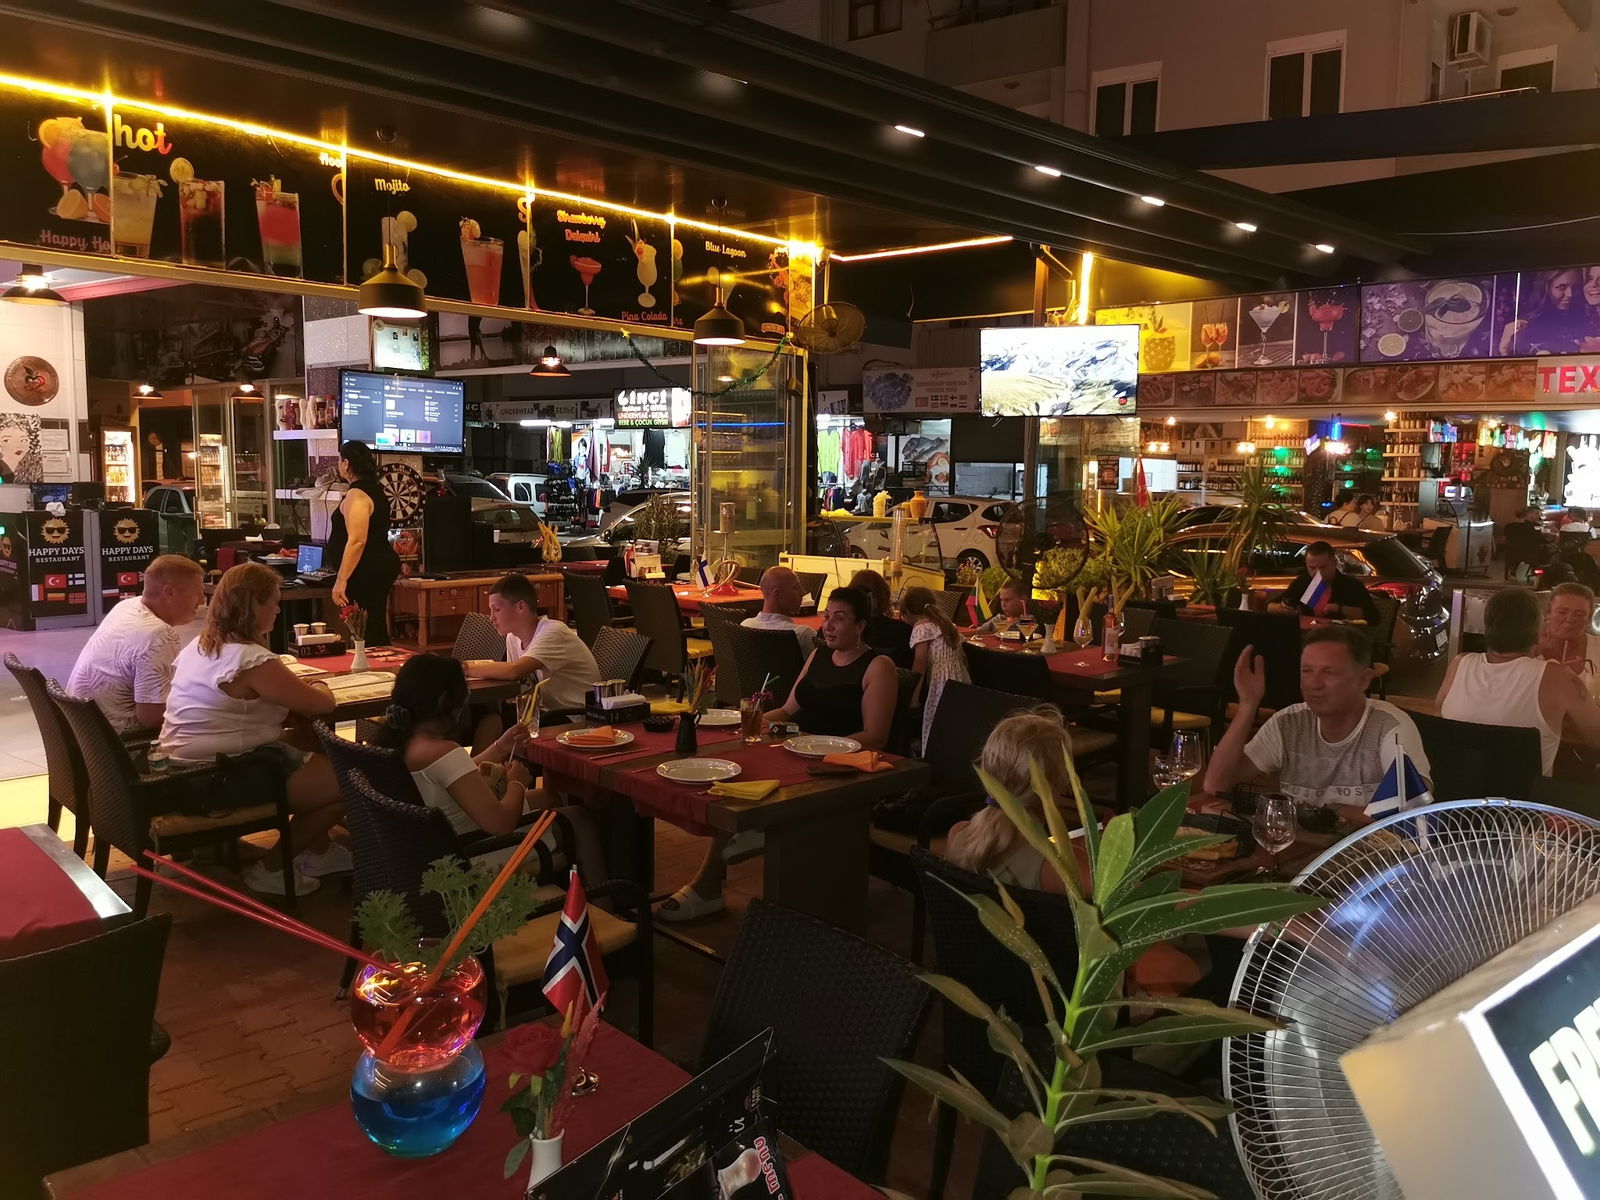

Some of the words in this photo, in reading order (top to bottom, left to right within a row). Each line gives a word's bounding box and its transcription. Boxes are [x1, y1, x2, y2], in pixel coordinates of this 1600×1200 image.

[113, 113, 173, 155] hot
[374, 178, 411, 195] Mojito
[556, 209, 607, 229] Strawberry
[40, 229, 88, 251] Happy
[705, 240, 721, 252] Blue
[722, 243, 747, 258] Lagoon
[641, 311, 669, 321] Colada
[1538, 365, 1600, 394] TEX
[500, 407, 534, 416] UNDERWEAR
[635, 419, 653, 427] ÇOCUK
[28, 547, 60, 557] HAPPY
[62, 546, 84, 555] DAYS
[102, 547, 131, 556] HAPPY
[133, 545, 153, 554] DAYS
[35, 555, 81, 563] RESTAURANT
[108, 554, 150, 562] RESTAURANT
[754, 1136, 780, 1194] menu
